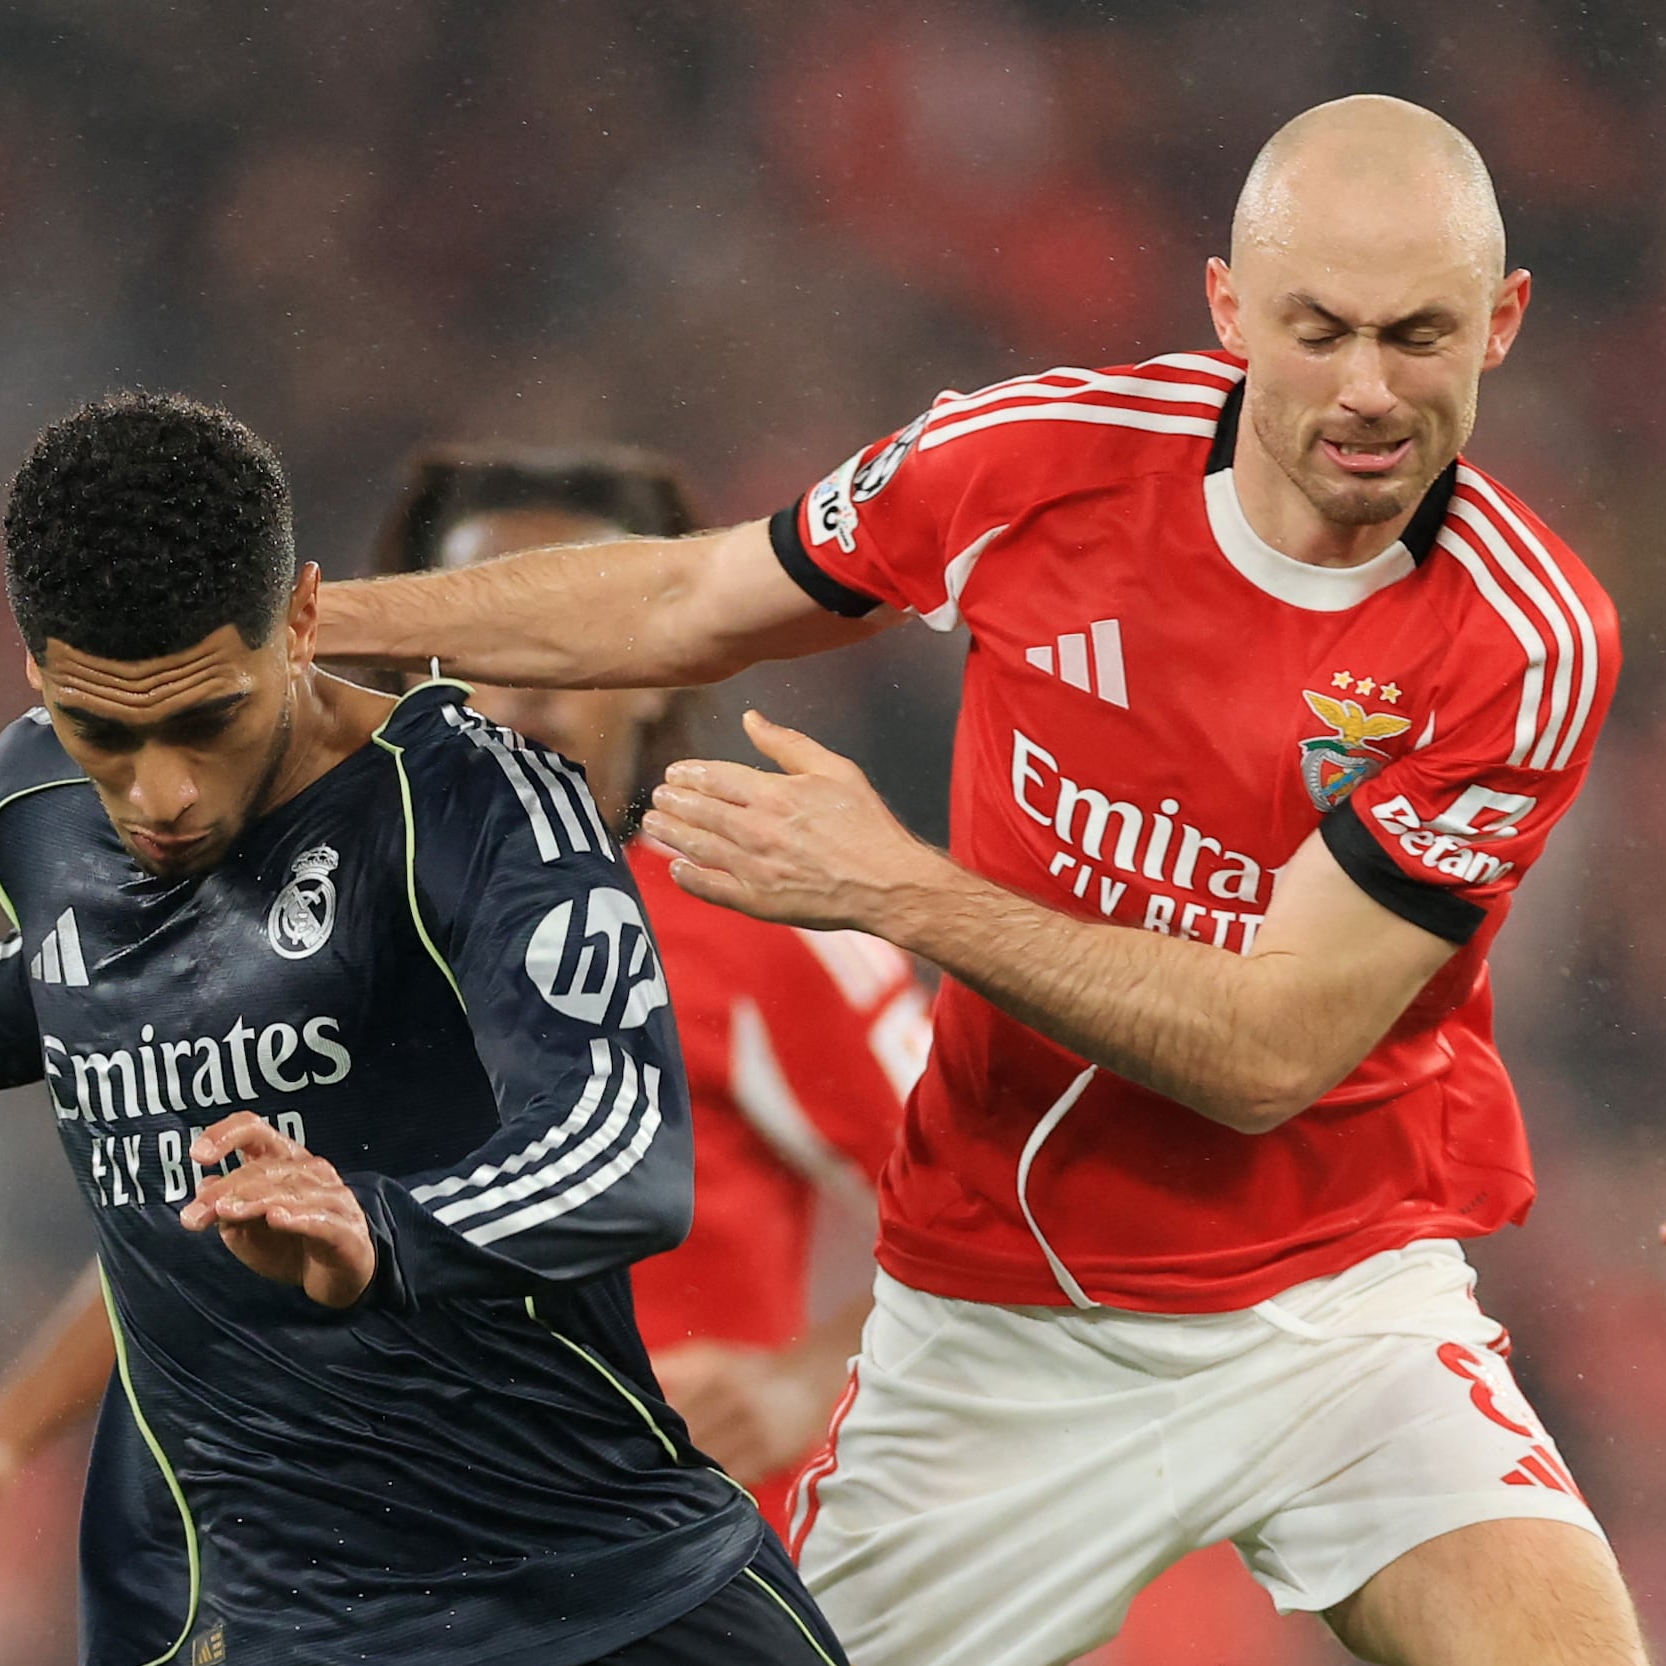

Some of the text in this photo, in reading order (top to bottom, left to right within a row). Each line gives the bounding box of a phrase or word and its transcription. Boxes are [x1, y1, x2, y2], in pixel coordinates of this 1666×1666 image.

[1011, 728, 1278, 904] Emira
[545, 888, 659, 1029] hp
[1144, 893, 1265, 957] BETT
[43, 1015, 352, 1122] Emirates
